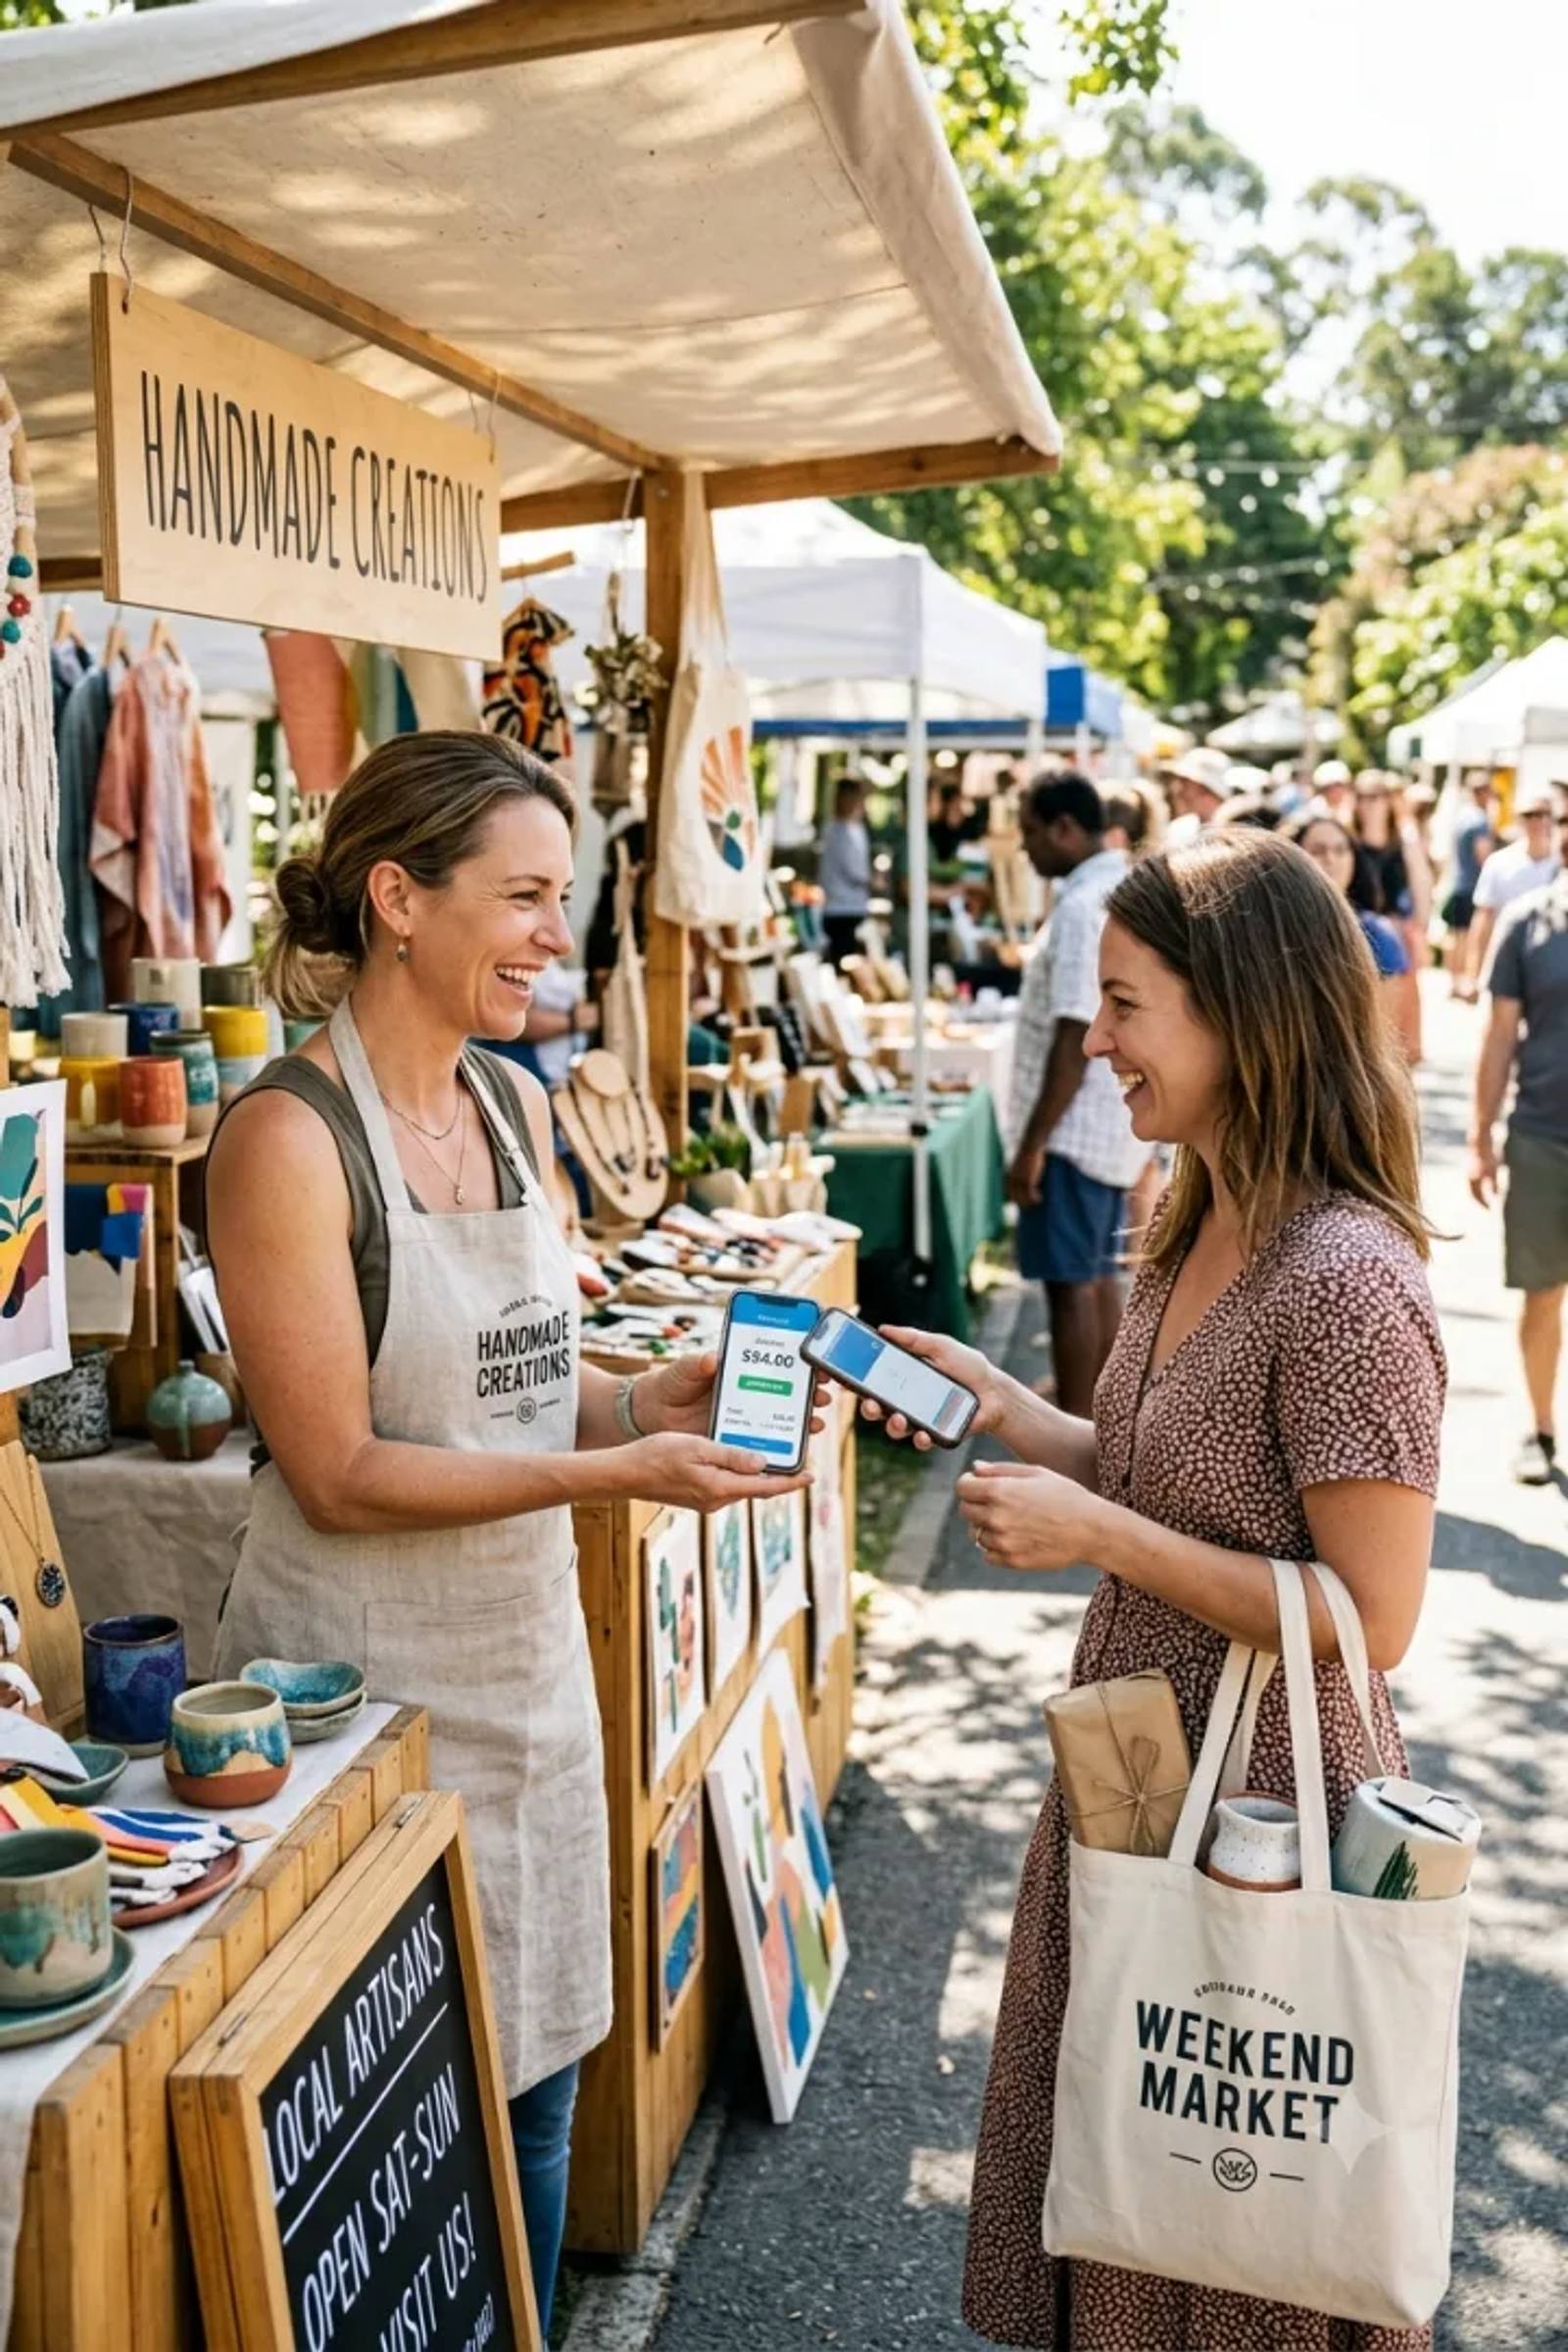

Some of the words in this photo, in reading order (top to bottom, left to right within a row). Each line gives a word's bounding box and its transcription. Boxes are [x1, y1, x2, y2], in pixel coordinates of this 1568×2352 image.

[141, 370, 341, 570] HANDMADE
[351, 446, 488, 604] CREATIONS
[476, 1348, 570, 1398] CREATIONS
[477, 1310, 569, 1361] HANDMADE
[262, 2045, 344, 2208] LOCAL
[343, 1902, 446, 2098] ARTISANS
[1136, 1999, 1354, 2087] WEEKEND
[1140, 2060, 1341, 2144] MARKET
[302, 2200, 371, 2352] OPEN
[369, 2063, 461, 2254] SAT-SUN
[438, 2190, 476, 2300] US!
